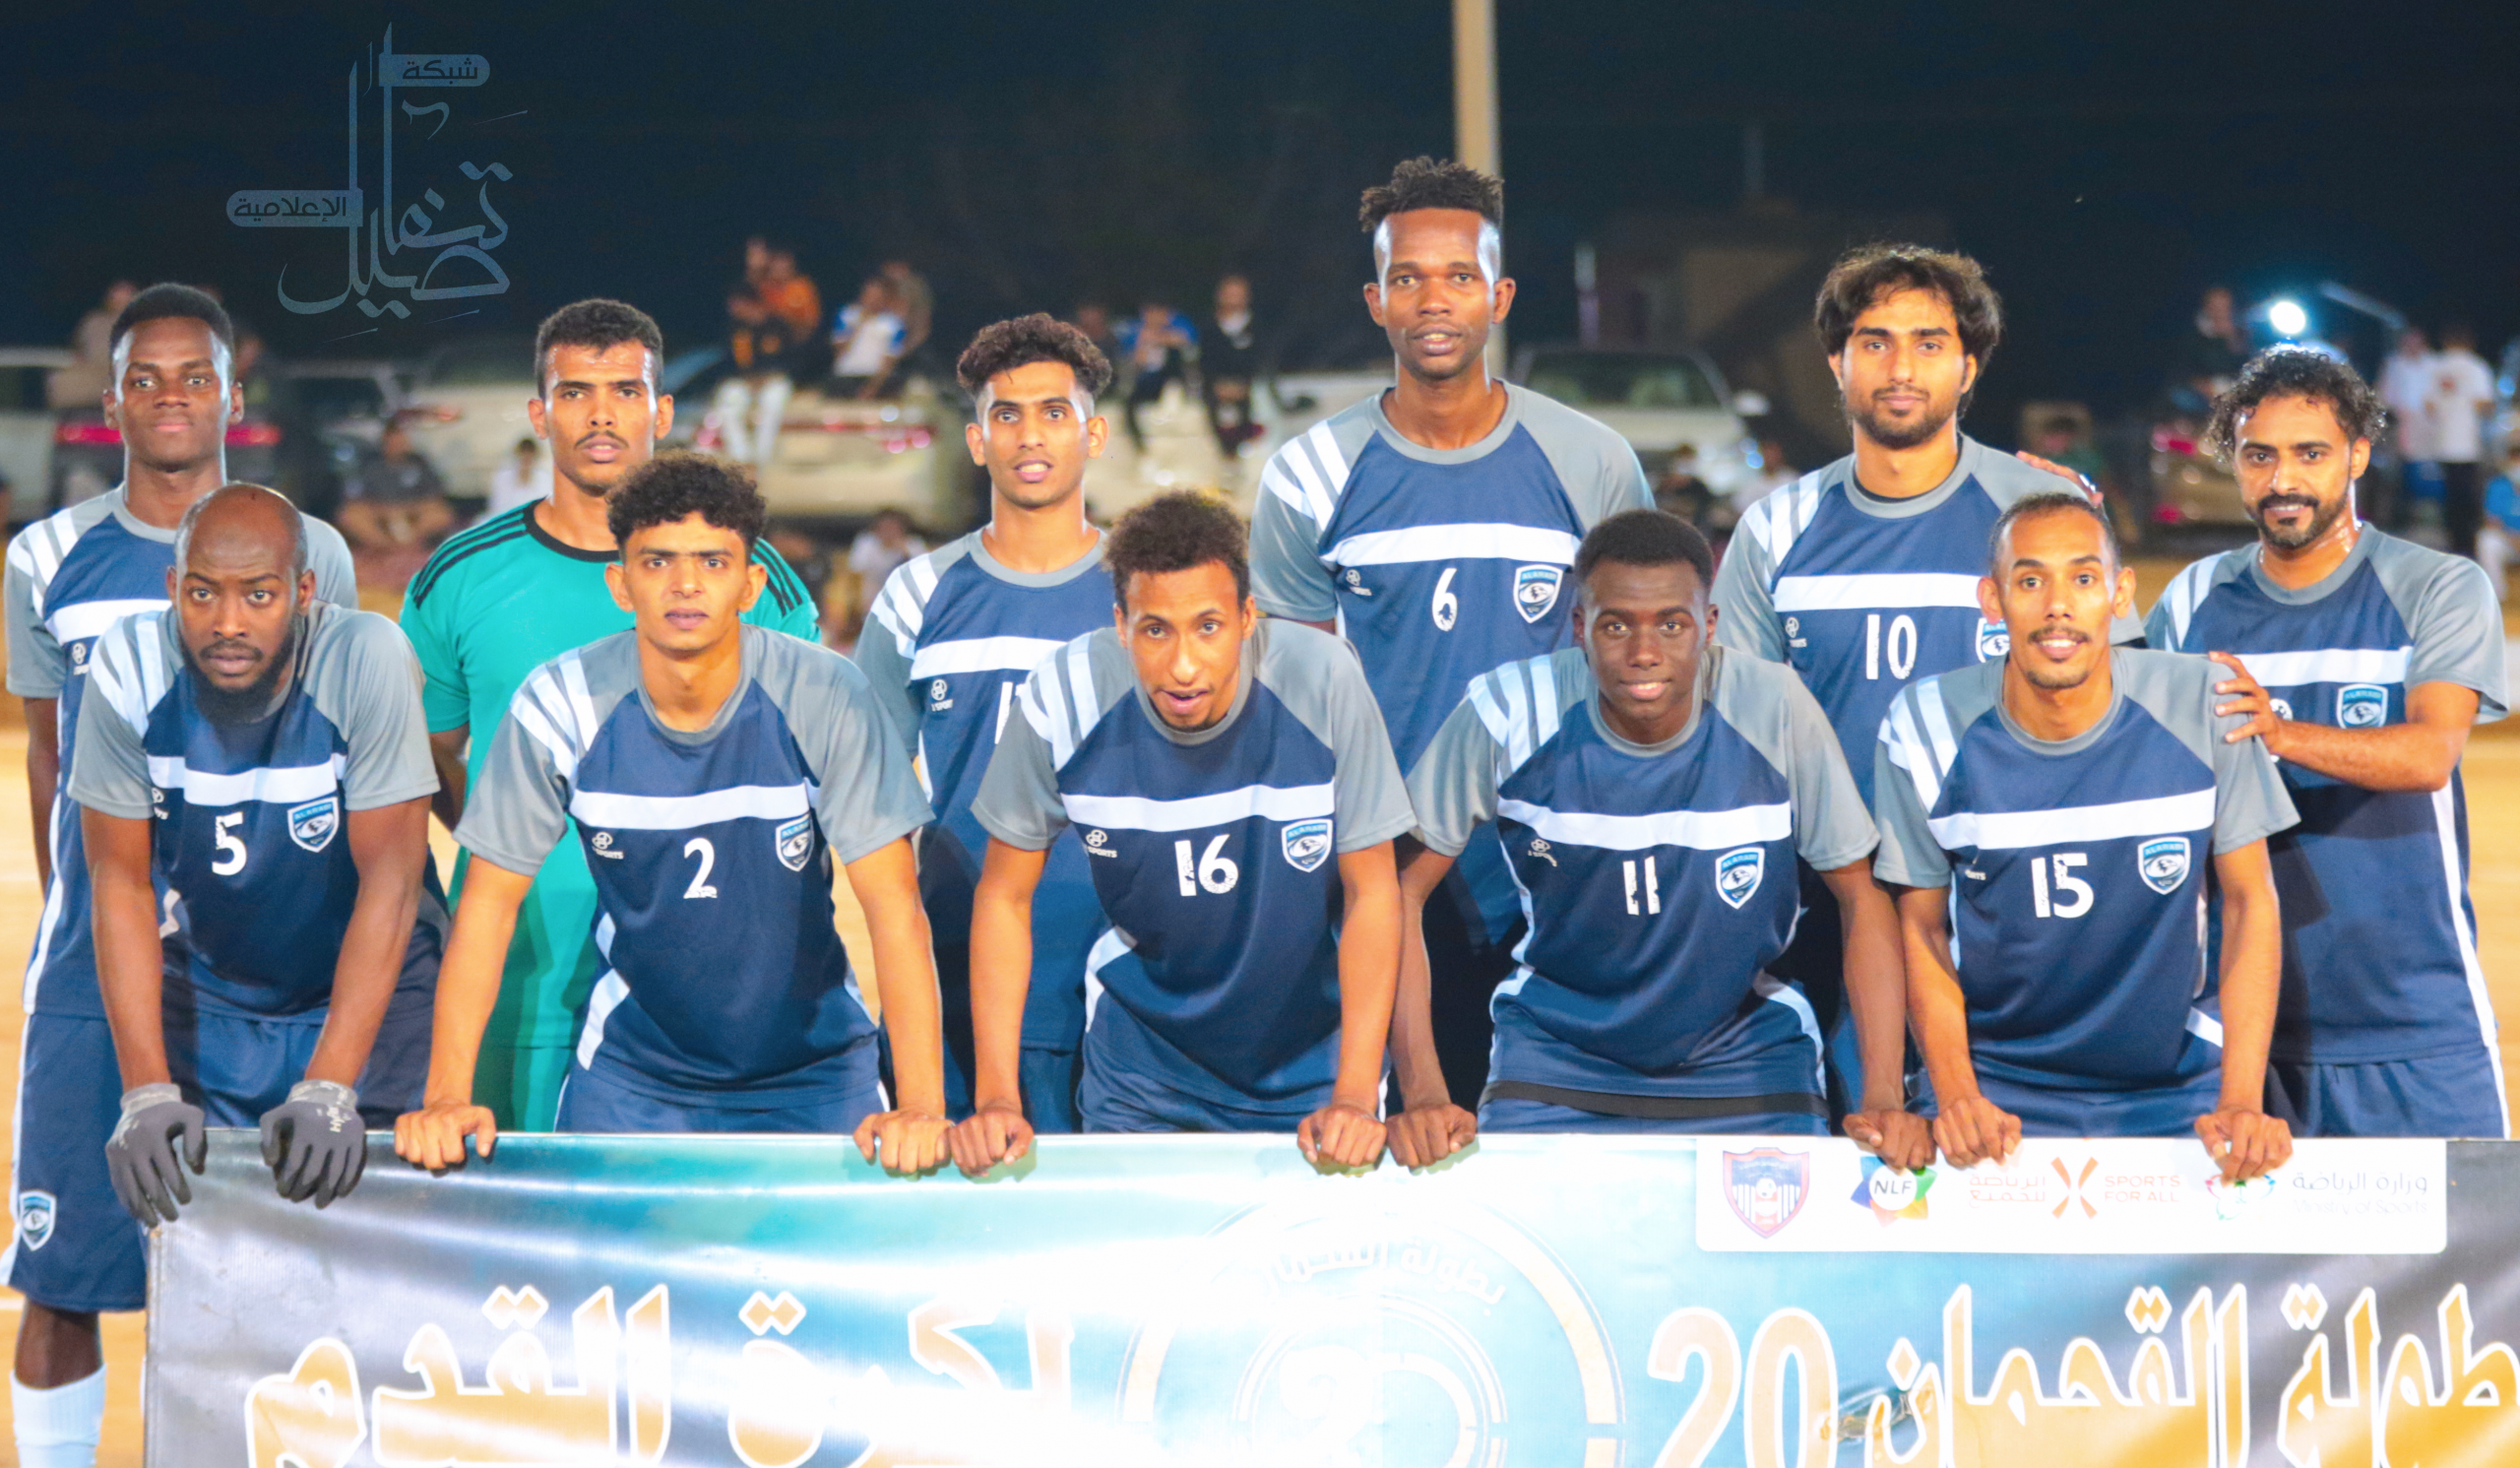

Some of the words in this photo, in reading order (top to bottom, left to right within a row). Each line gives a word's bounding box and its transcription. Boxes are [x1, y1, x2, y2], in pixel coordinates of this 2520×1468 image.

[1431, 567, 1458, 632] 6
[1865, 613, 1918, 680] 10
[994, 681, 1027, 745] 1
[212, 810, 247, 876] 5
[683, 837, 719, 899] 2
[1174, 833, 1239, 897] 16
[1623, 856, 1662, 916] 11
[2031, 853, 2095, 919] 15
[1873, 1180, 1913, 1195] NLF
[2104, 1175, 2181, 1187] SPORTS
[2104, 1190, 2142, 1203] FOR
[2146, 1190, 2181, 1203] ALL
[2292, 1172, 2366, 1196] الرياضة
[2375, 1172, 2428, 1196] وزارة
[2375, 1198, 2428, 1217] Sports
[1400, 1237, 1507, 1317] بطولة
[243, 1283, 671, 1468] القدم
[1648, 1306, 1840, 1468] 20
